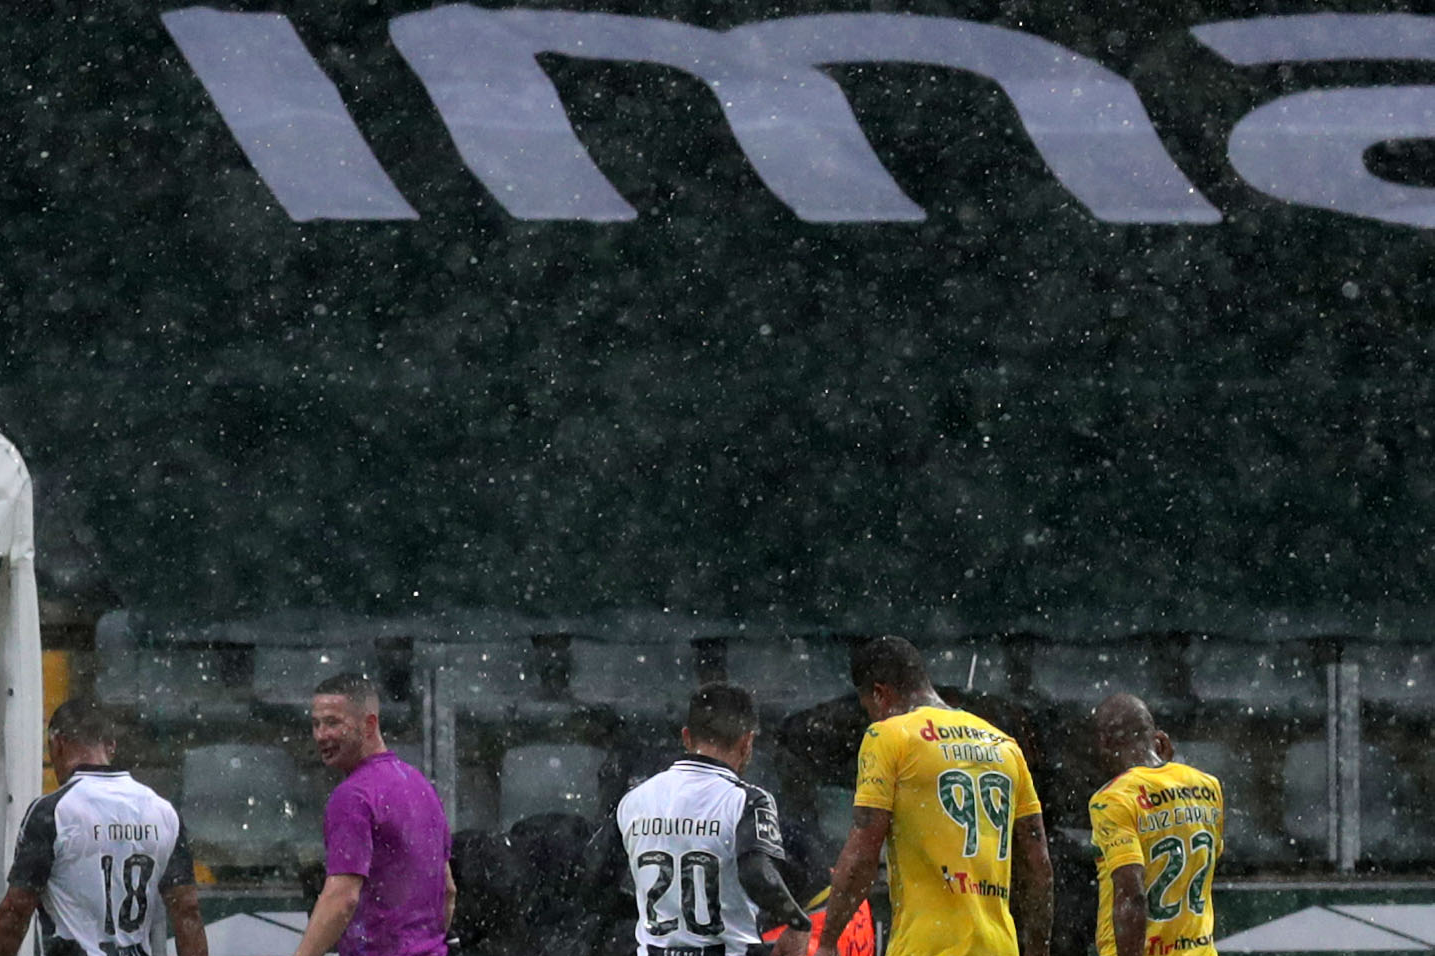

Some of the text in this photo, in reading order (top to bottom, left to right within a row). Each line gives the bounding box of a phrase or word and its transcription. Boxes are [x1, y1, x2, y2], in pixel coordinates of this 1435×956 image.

[108, 824, 159, 841] MOUFI
[937, 768, 1013, 861] 99
[101, 853, 156, 936] 18
[637, 850, 726, 937] 20
[1146, 829, 1214, 922] 22
